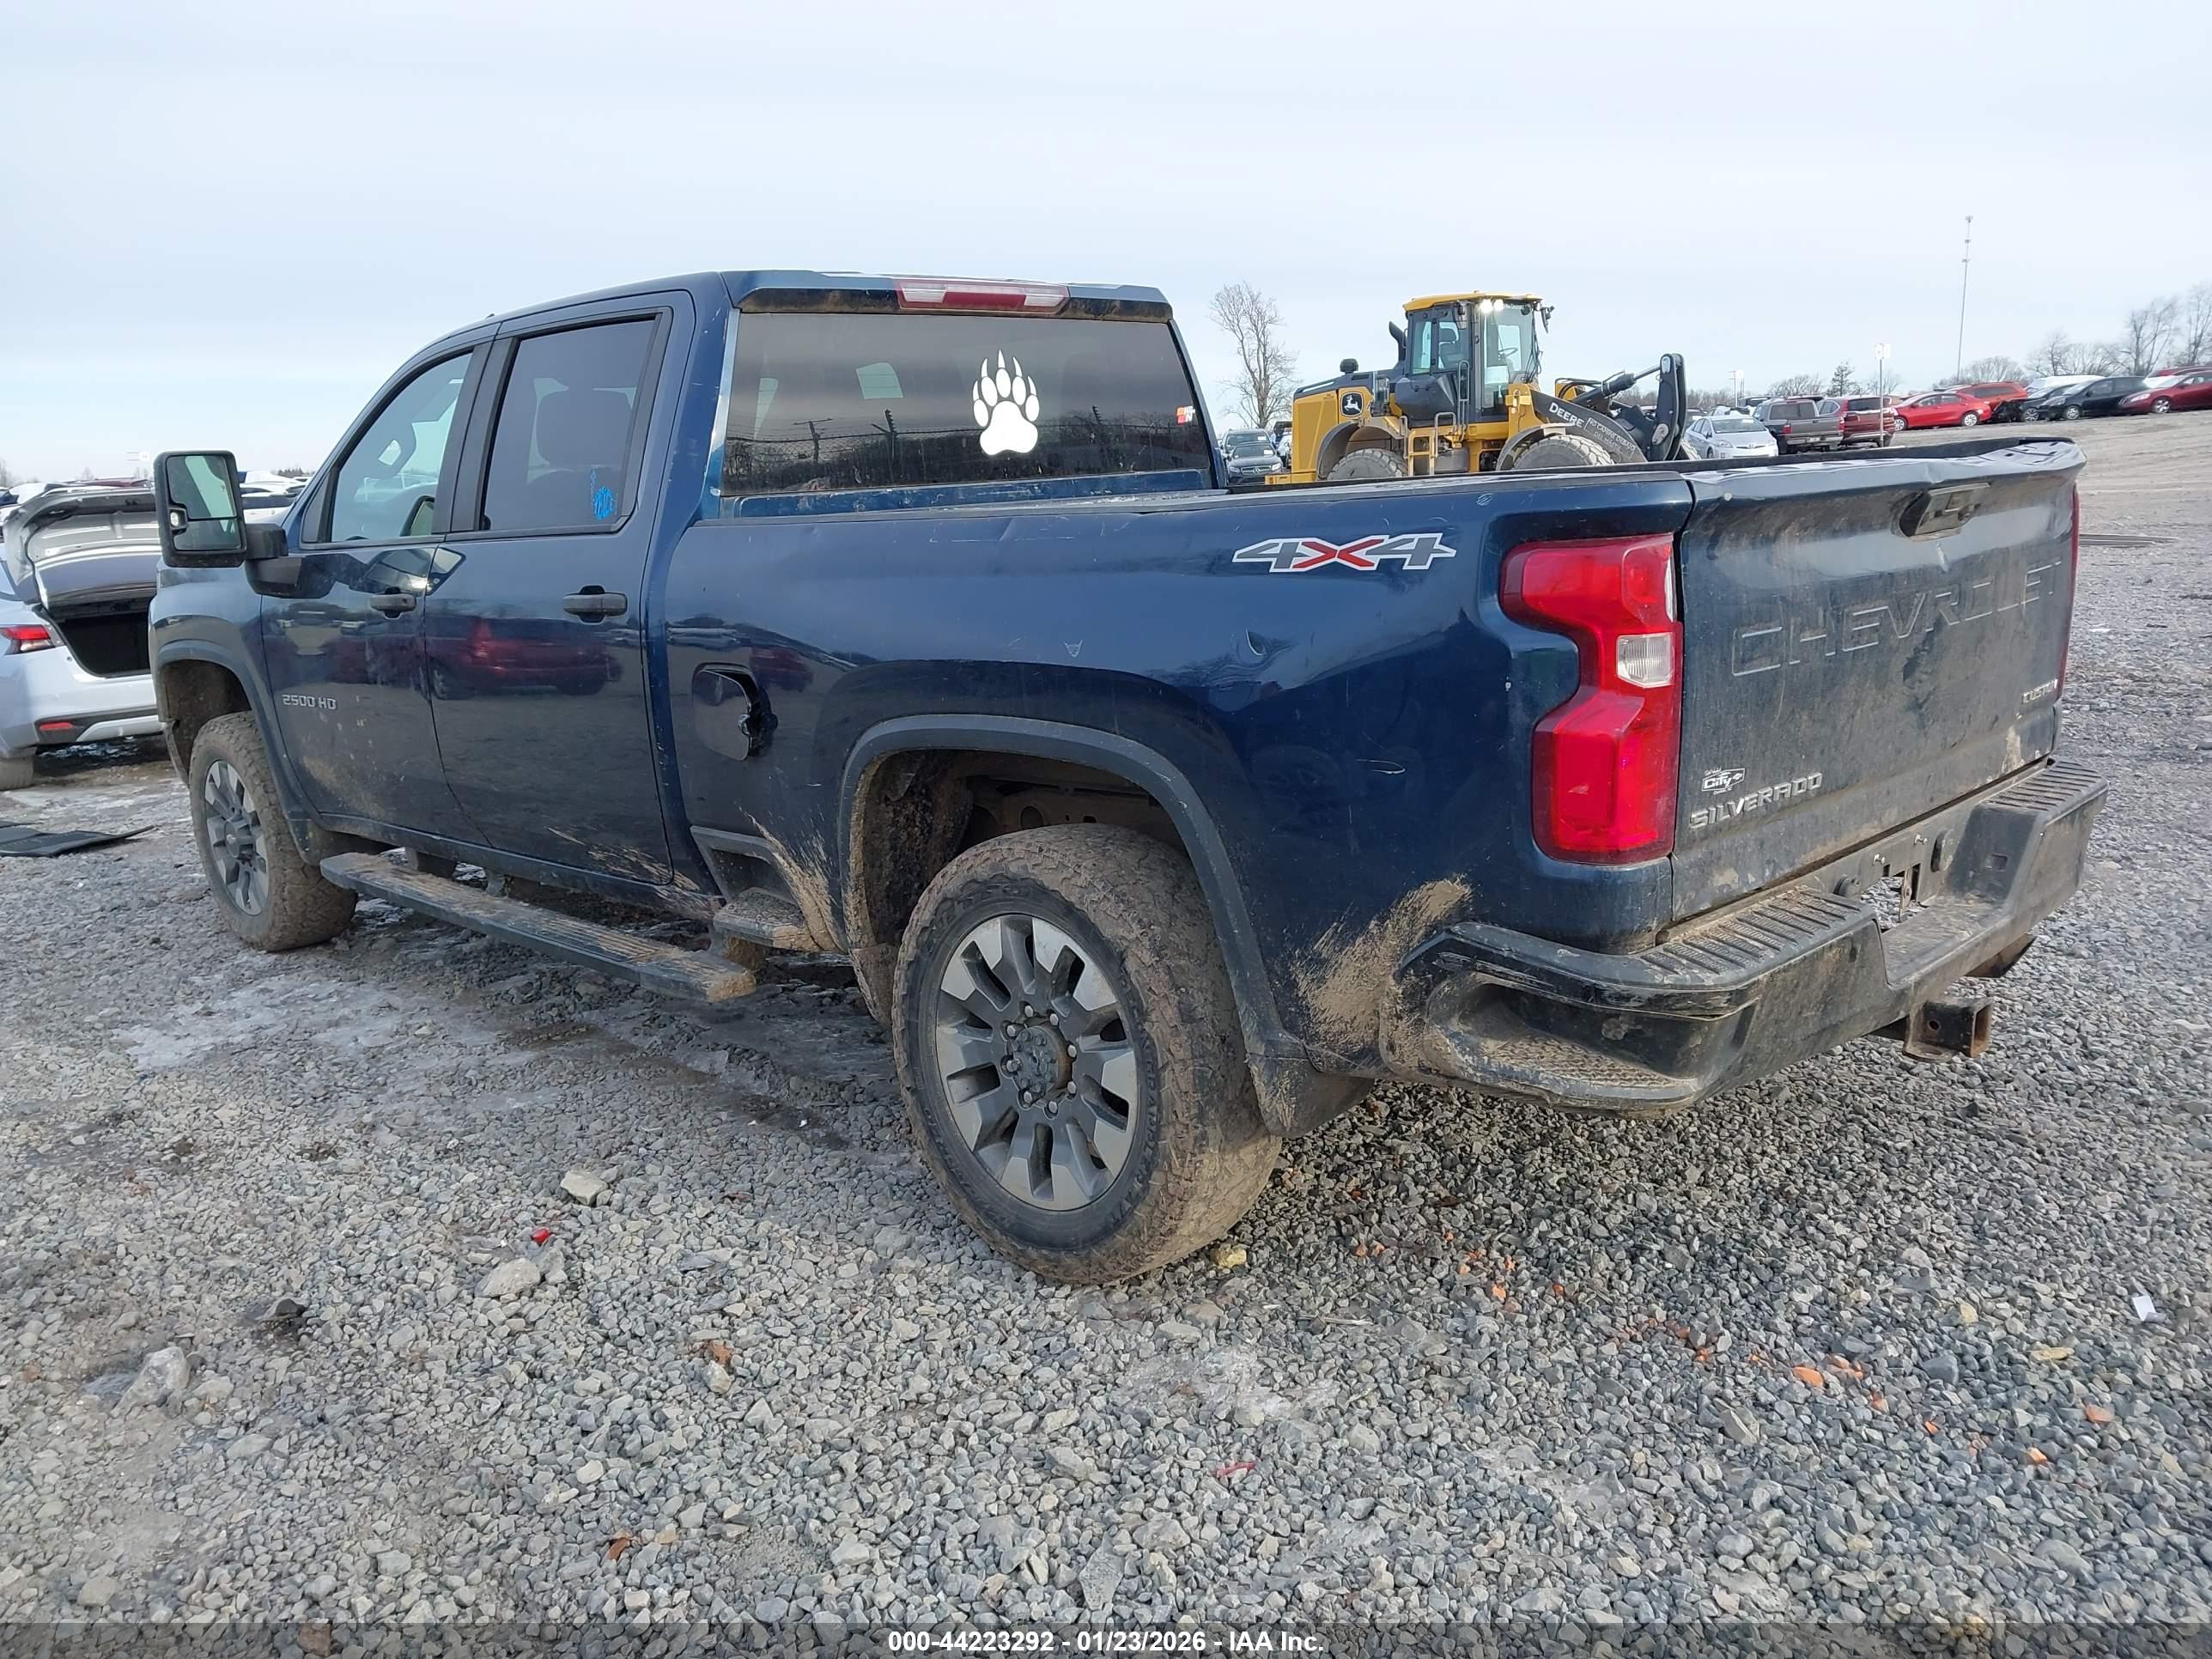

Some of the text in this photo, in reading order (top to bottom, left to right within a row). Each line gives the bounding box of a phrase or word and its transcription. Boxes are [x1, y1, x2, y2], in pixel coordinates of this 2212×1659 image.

[1549, 402, 1584, 428] DEERE
[1731, 560, 2062, 677] CHEVROLET
[282, 694, 337, 710] 2500 HD
[1689, 772, 1822, 829] SILVERADO
